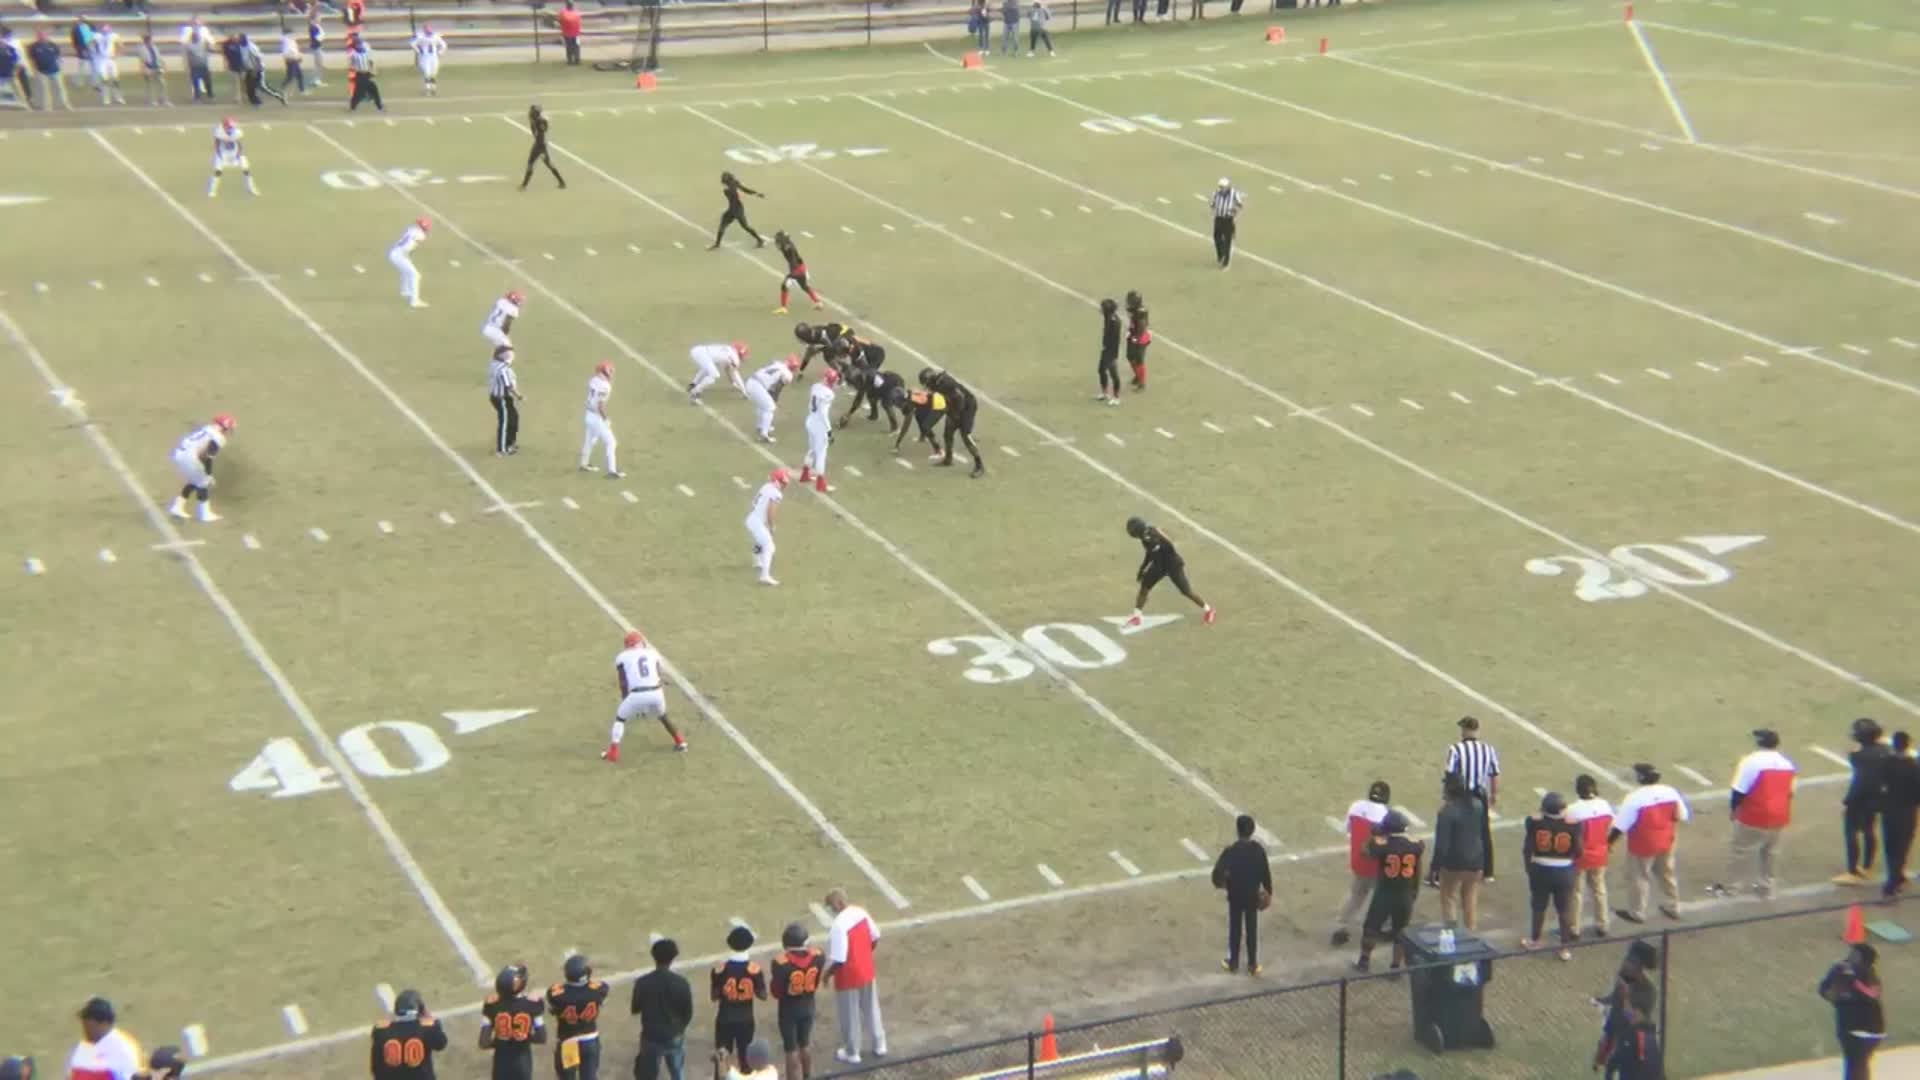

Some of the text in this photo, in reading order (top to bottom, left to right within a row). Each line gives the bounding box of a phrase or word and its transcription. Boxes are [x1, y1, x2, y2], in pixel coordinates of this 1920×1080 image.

[1524, 544, 1732, 602] 20
[637, 655, 650, 678] 6
[927, 622, 1127, 683] 30
[229, 719, 452, 798] 40
[1383, 853, 1417, 880] 33
